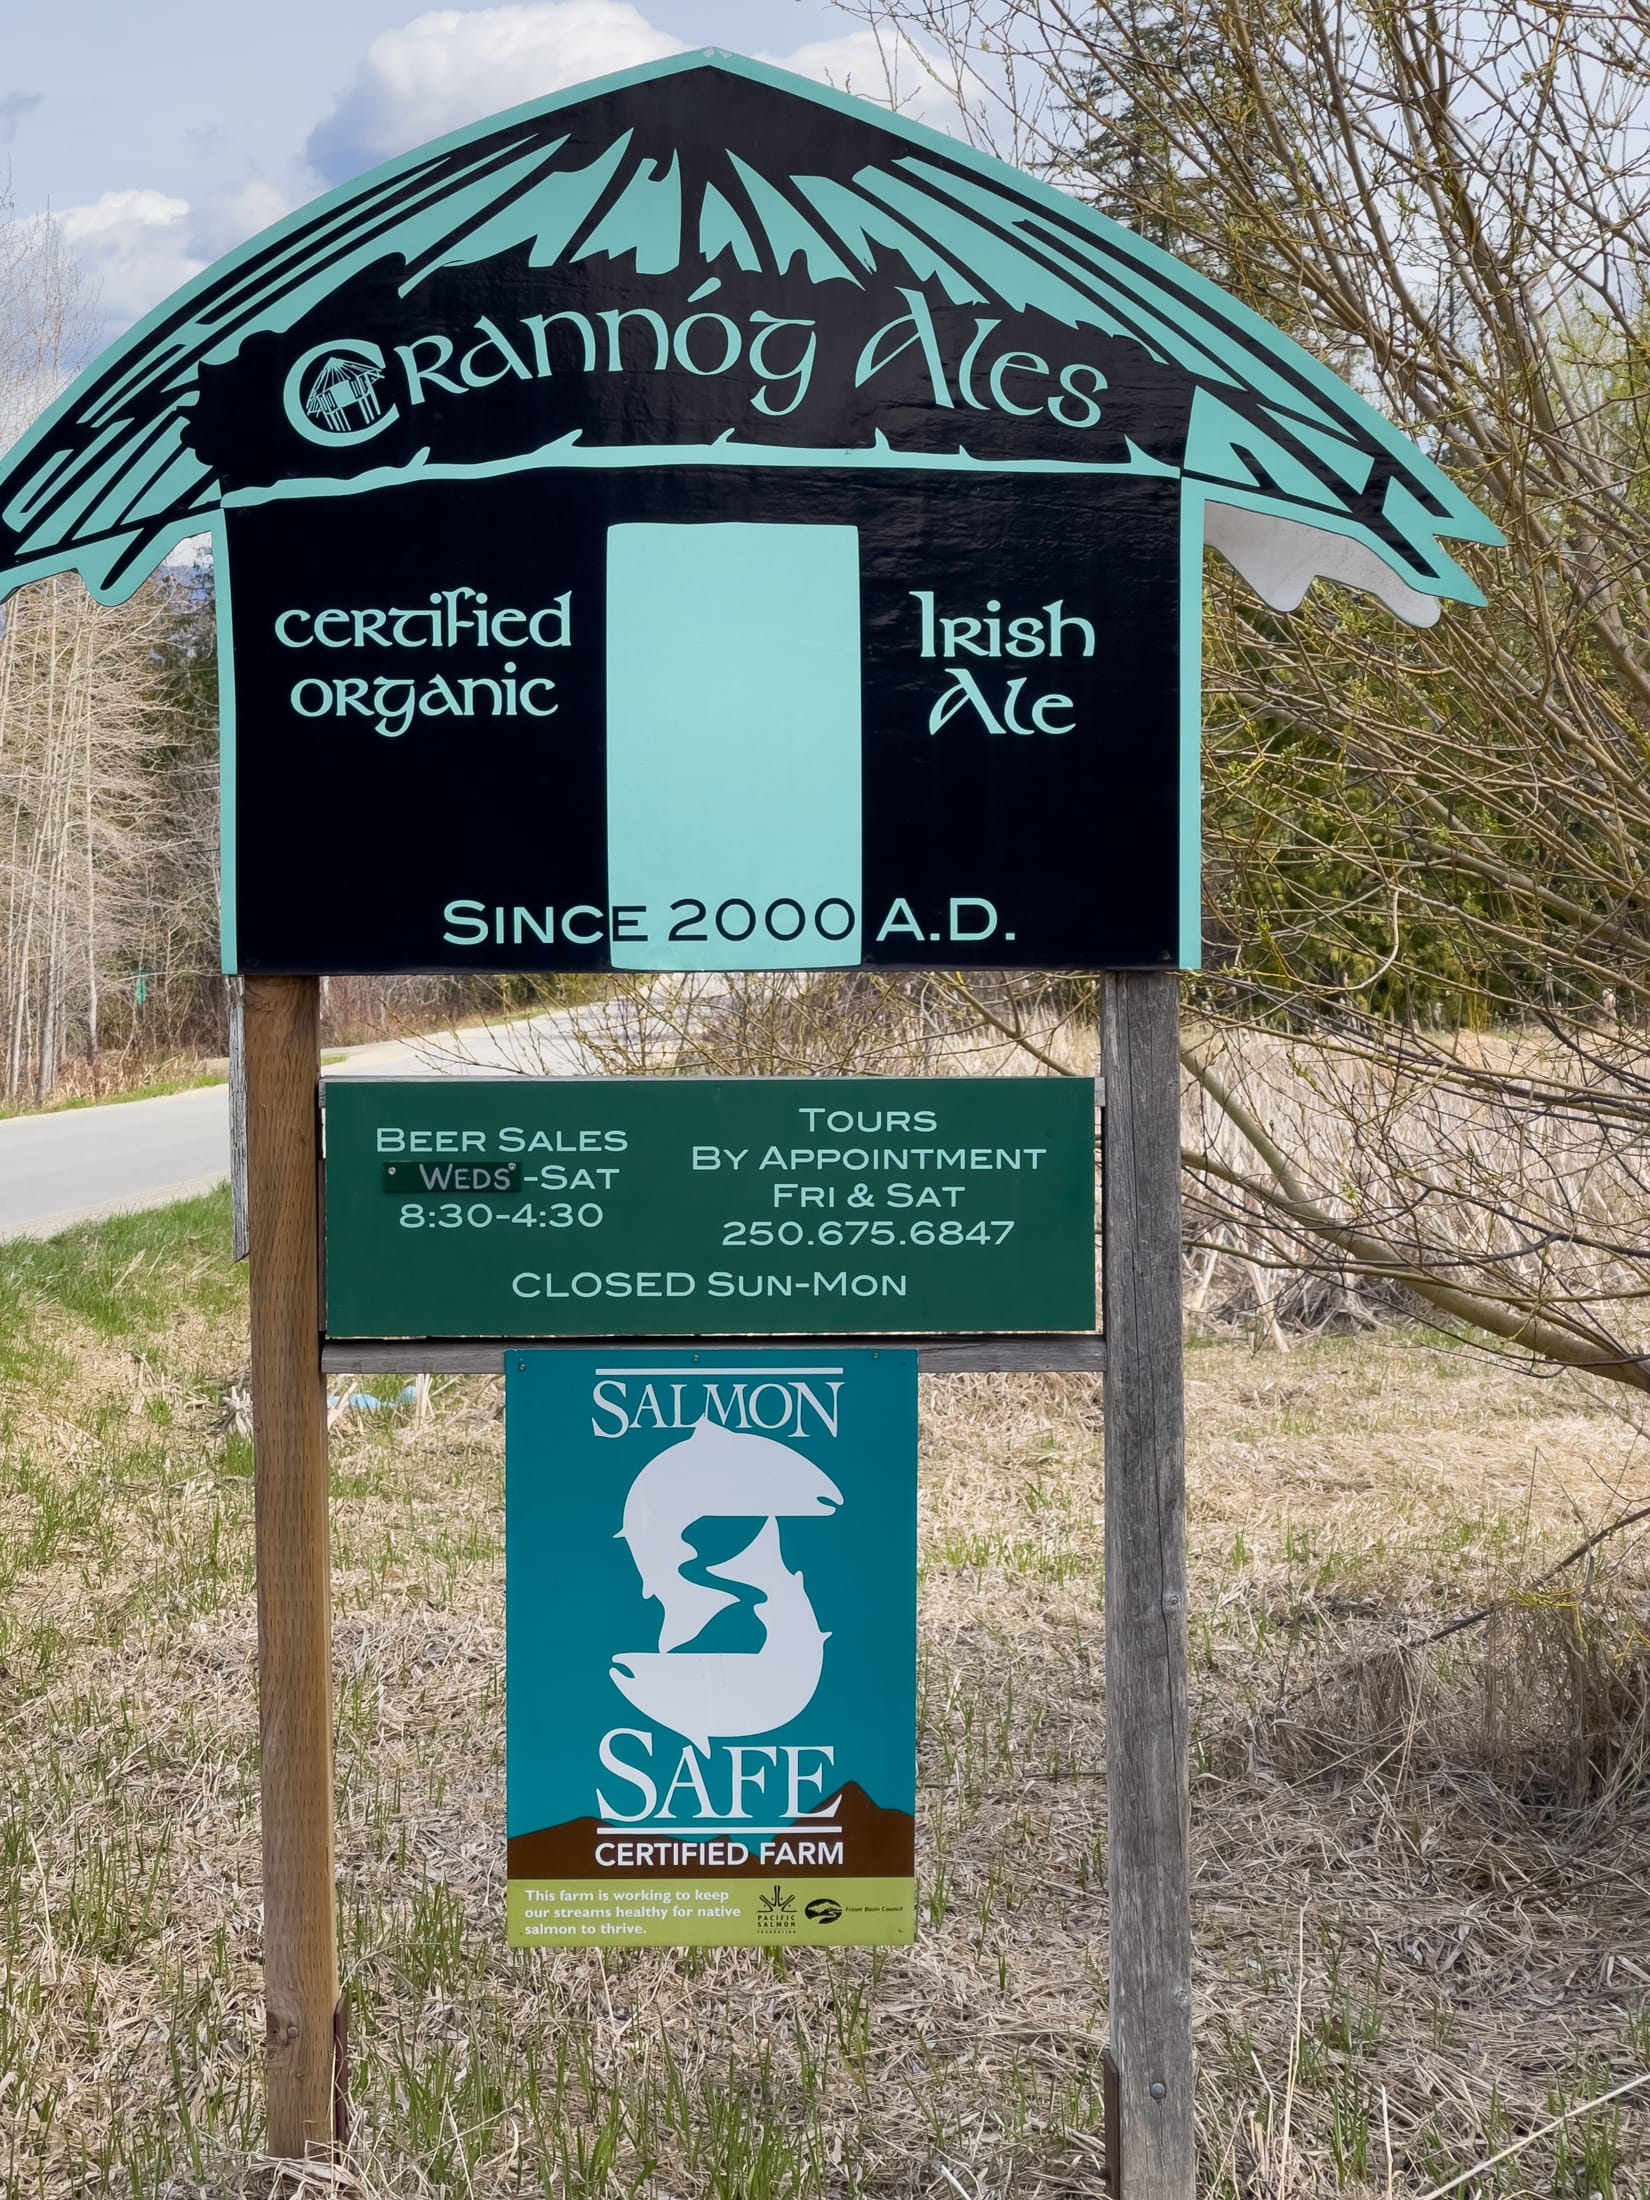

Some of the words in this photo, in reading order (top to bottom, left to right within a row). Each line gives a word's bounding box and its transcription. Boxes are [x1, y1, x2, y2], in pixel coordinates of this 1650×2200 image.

[856, 286, 1108, 428] Ales
[275, 587, 572, 647] certified
[909, 591, 1095, 657] Irish
[291, 662, 558, 737] organic
[929, 668, 1076, 735] Ale
[668, 898, 855, 941] 2000
[876, 898, 1015, 941] A.D.
[847, 1184, 874, 1207] &
[400, 1203, 602, 1227] 8:30-4:30
[723, 1221, 1014, 1246] 250.675.6847
[513, 1272, 695, 1297] CLOSED
[592, 1380, 845, 1438] SALMON
[596, 1728, 842, 1821] SAFE
[595, 1842, 748, 1866] CERTIFIED
[760, 1842, 843, 1865] FARM
[524, 1889, 556, 1902] This
[560, 1889, 594, 1902] farm
[599, 1889, 609, 1901] is
[613, 1889, 672, 1904] working
[675, 1891, 691, 1901] to
[695, 1889, 729, 1904] keep
[524, 1908, 550, 1918] our
[554, 1908, 612, 1918] streams
[616, 1906, 669, 1920] healthy
[672, 1906, 694, 1917] for
[697, 1906, 741, 1917] native
[524, 1923, 577, 1935] salmon
[580, 1924, 596, 1934] to
[600, 1922, 647, 1934] thrive.
